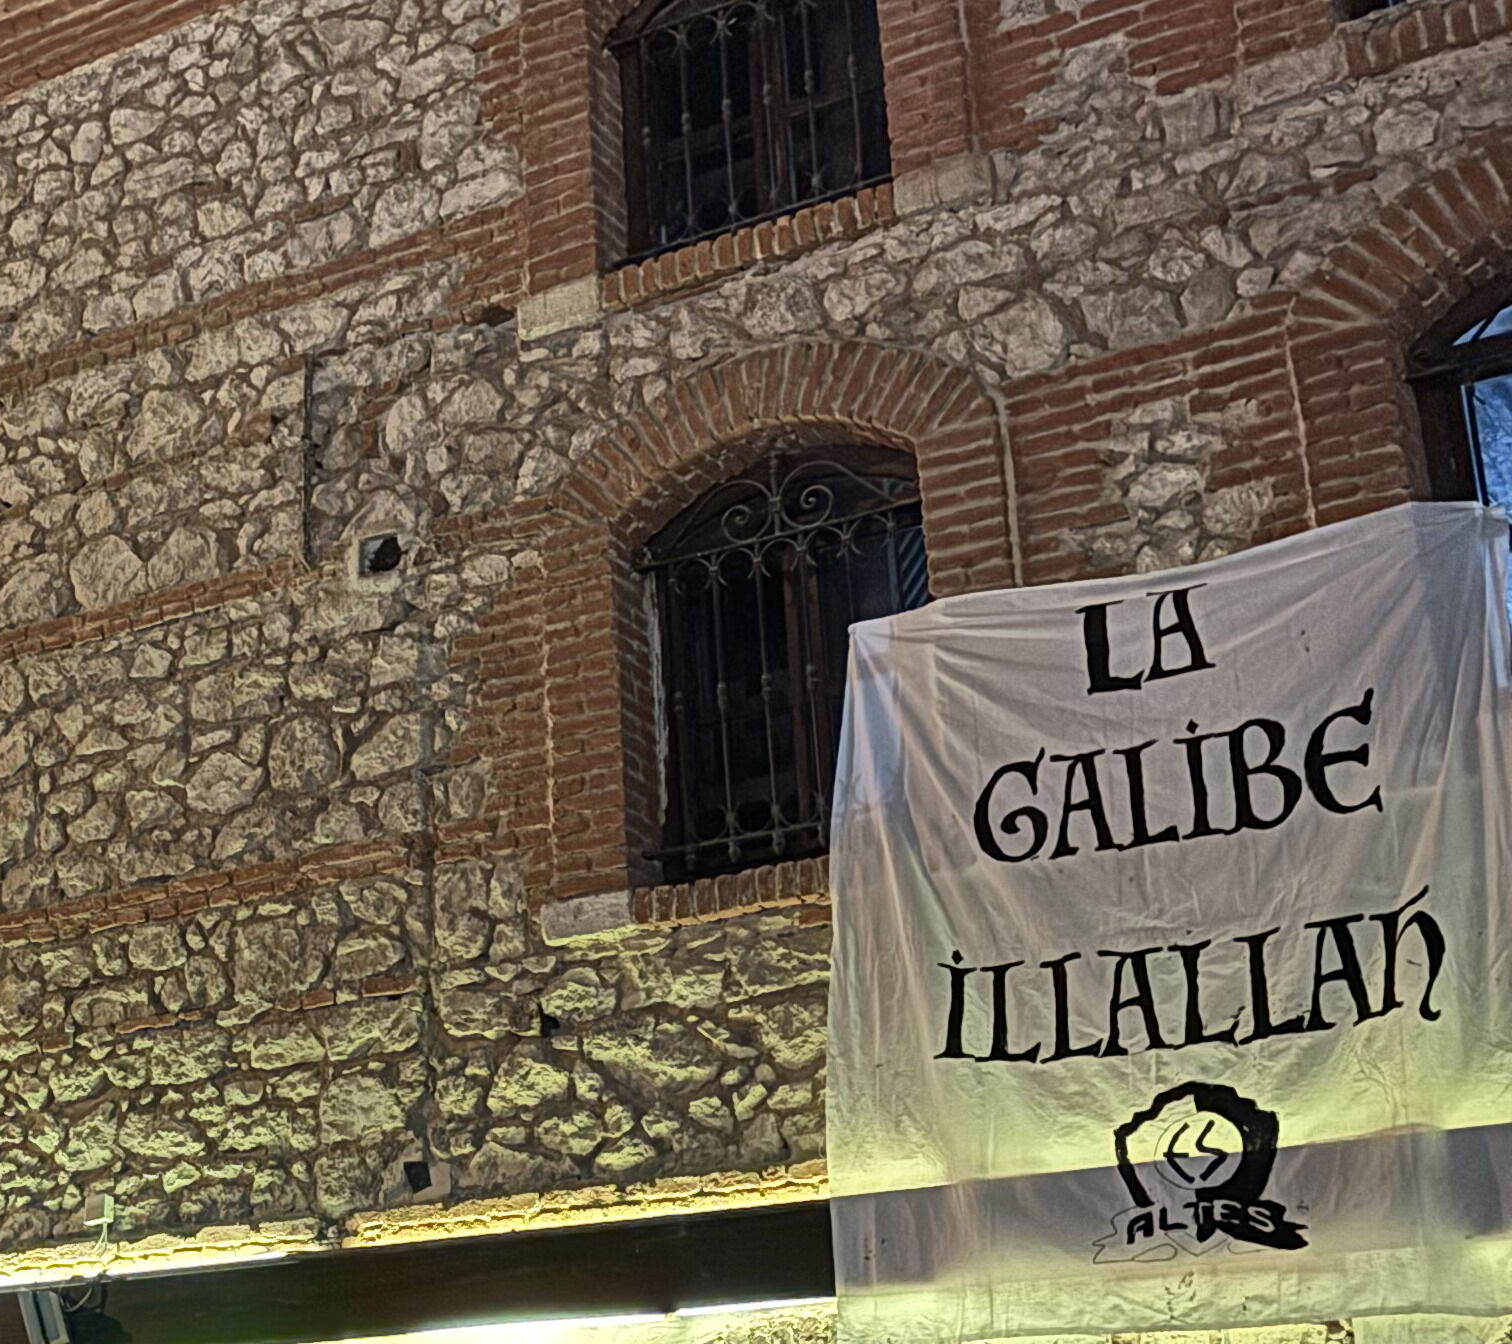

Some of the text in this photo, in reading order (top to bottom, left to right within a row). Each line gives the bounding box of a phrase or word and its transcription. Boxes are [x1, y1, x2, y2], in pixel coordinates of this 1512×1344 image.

[1075, 583, 1216, 695] LA
[973, 687, 1383, 862] GALİBE
[1125, 1199, 1276, 1245] ALTES
